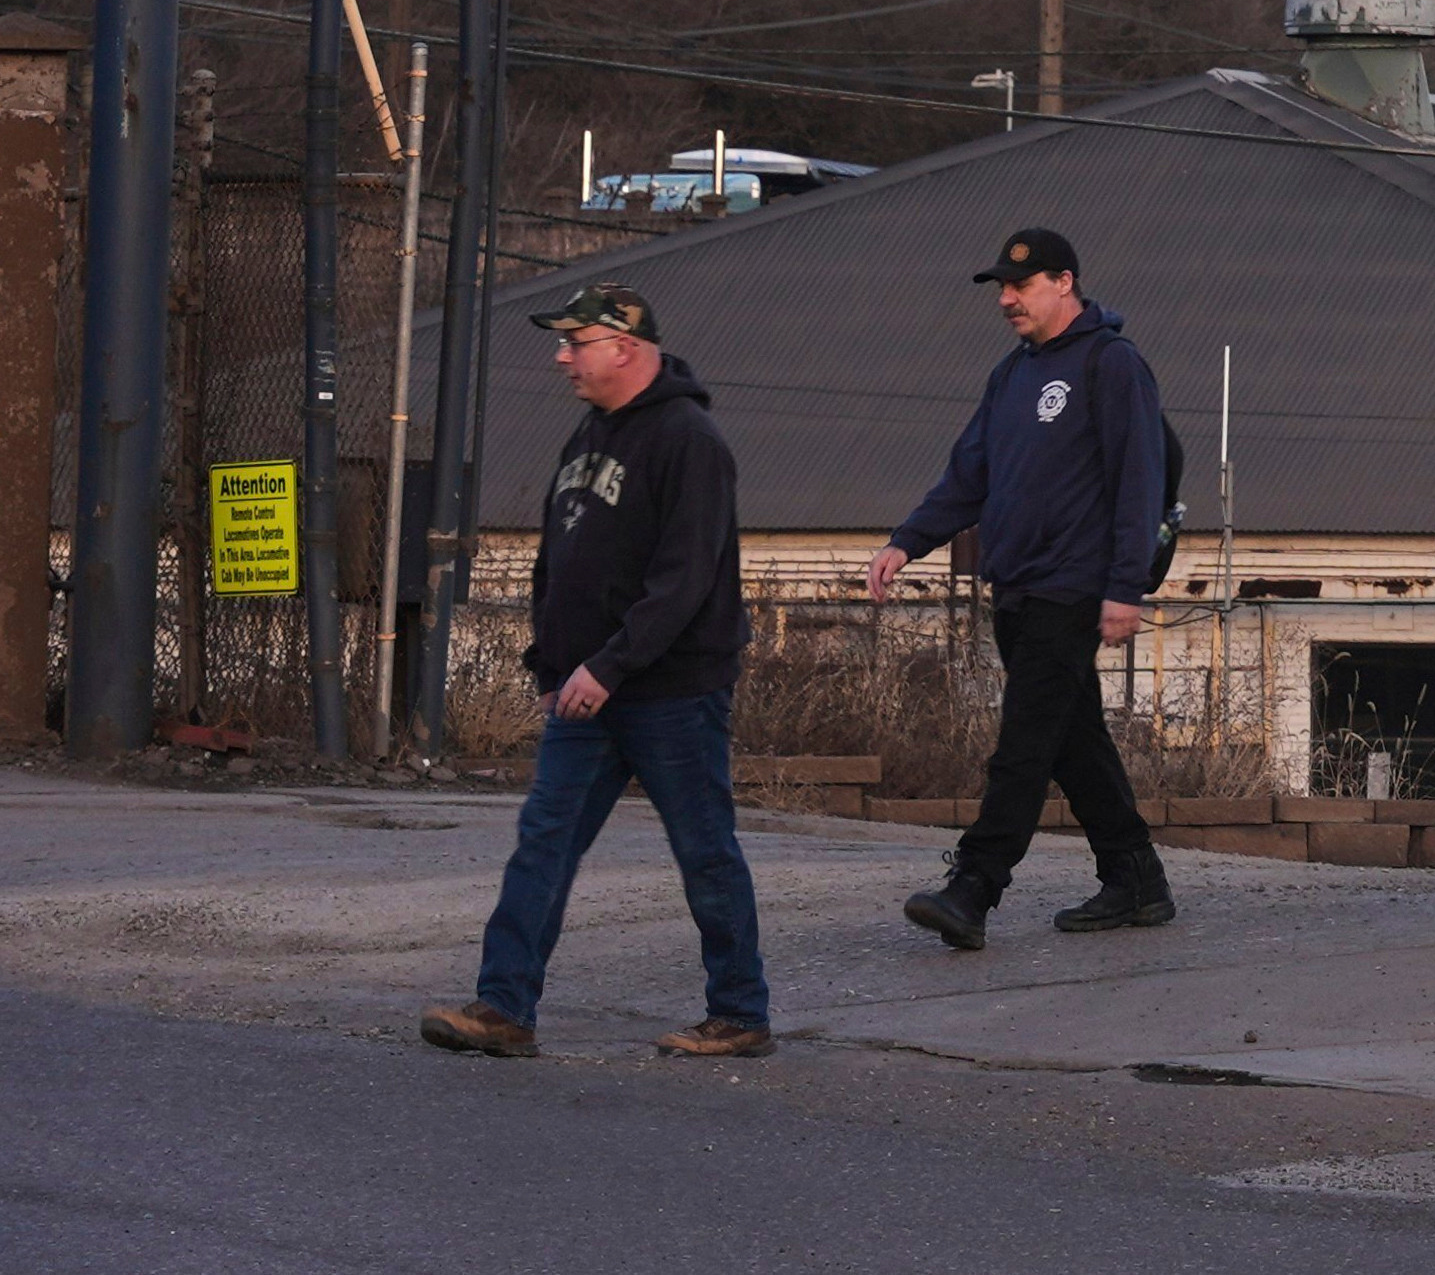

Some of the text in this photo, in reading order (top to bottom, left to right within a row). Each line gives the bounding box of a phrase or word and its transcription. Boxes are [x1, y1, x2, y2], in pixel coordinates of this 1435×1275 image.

[220, 473, 286, 496] Attention
[231, 504, 275, 521] Remote Control
[223, 525, 284, 542] Locomotives Operate
[219, 549, 226, 563] In
[226, 548, 239, 562] This
[256, 546, 290, 562] Locomotive
[221, 565, 290, 586] Cab May Be Unoccupied
